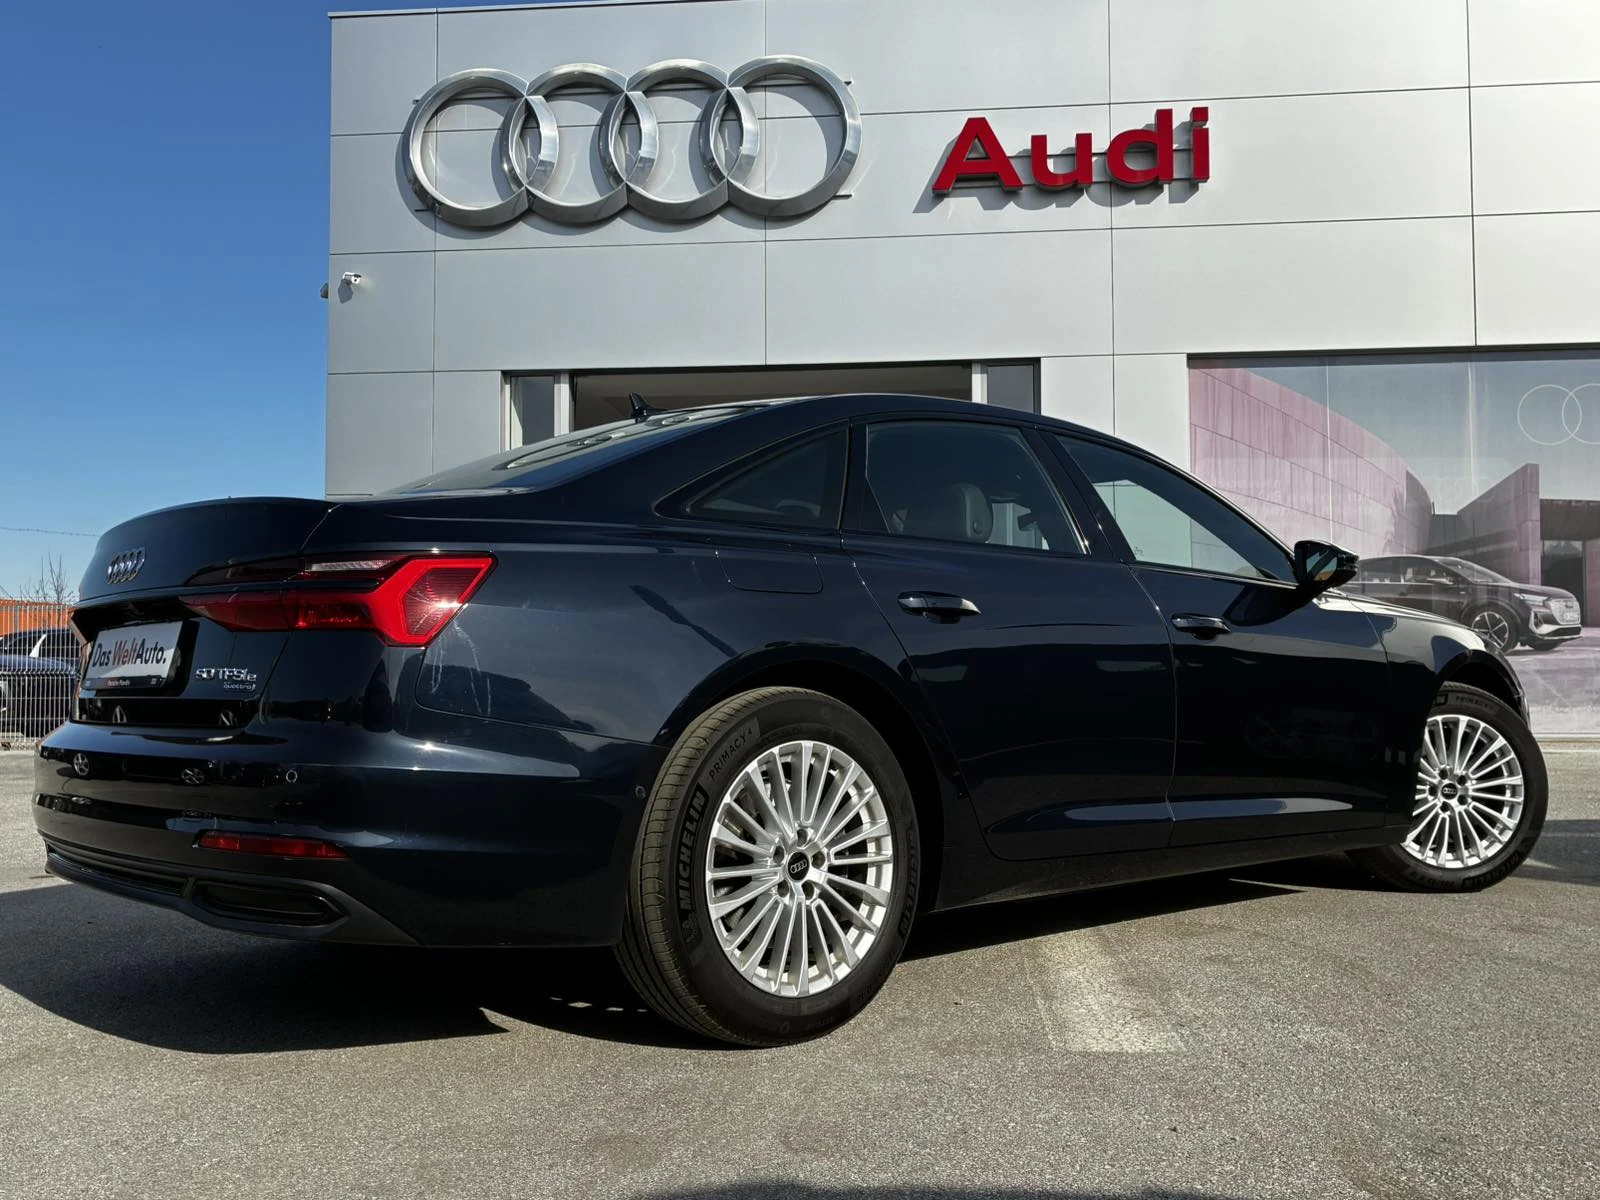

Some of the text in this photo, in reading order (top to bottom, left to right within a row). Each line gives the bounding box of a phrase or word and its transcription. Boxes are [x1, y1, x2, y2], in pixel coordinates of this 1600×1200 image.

[932, 106, 1210, 194] Audi
[92, 642, 112, 668] Das
[708, 731, 746, 781] PRIMACY
[678, 791, 707, 912] MICHELIN
